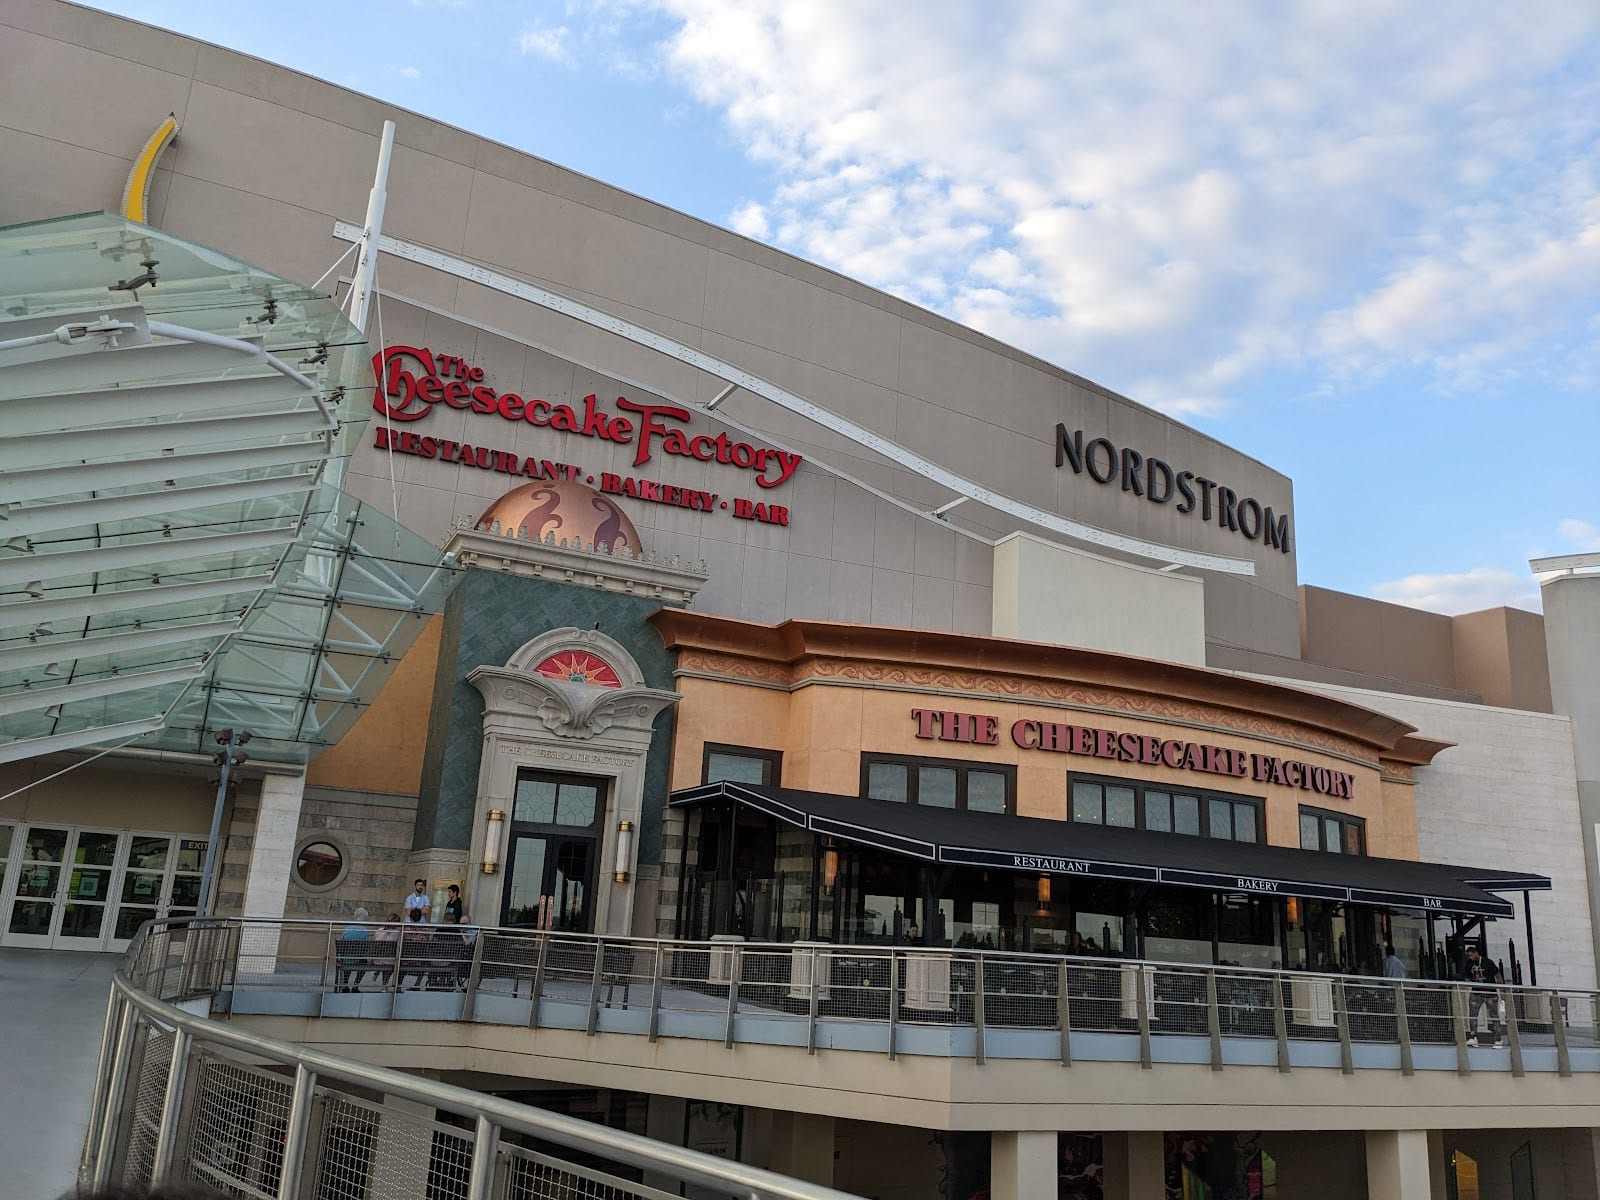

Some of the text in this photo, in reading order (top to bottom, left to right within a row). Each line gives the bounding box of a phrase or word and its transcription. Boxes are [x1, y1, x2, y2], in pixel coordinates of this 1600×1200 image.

[371, 345, 803, 488] The Cheesecake Factory
[373, 426, 789, 526] RESTAURANT BAKERY BAR
[1055, 422, 1291, 553] NORDSTROM
[500, 744, 521, 755] THE
[591, 754, 634, 768] FACTORY
[911, 708, 1356, 799] THE CHEESECAKE FACTORY
[1013, 856, 1090, 872] RESTAURANT
[1237, 878, 1279, 892] BAKERY
[1423, 898, 1442, 908] BAR
